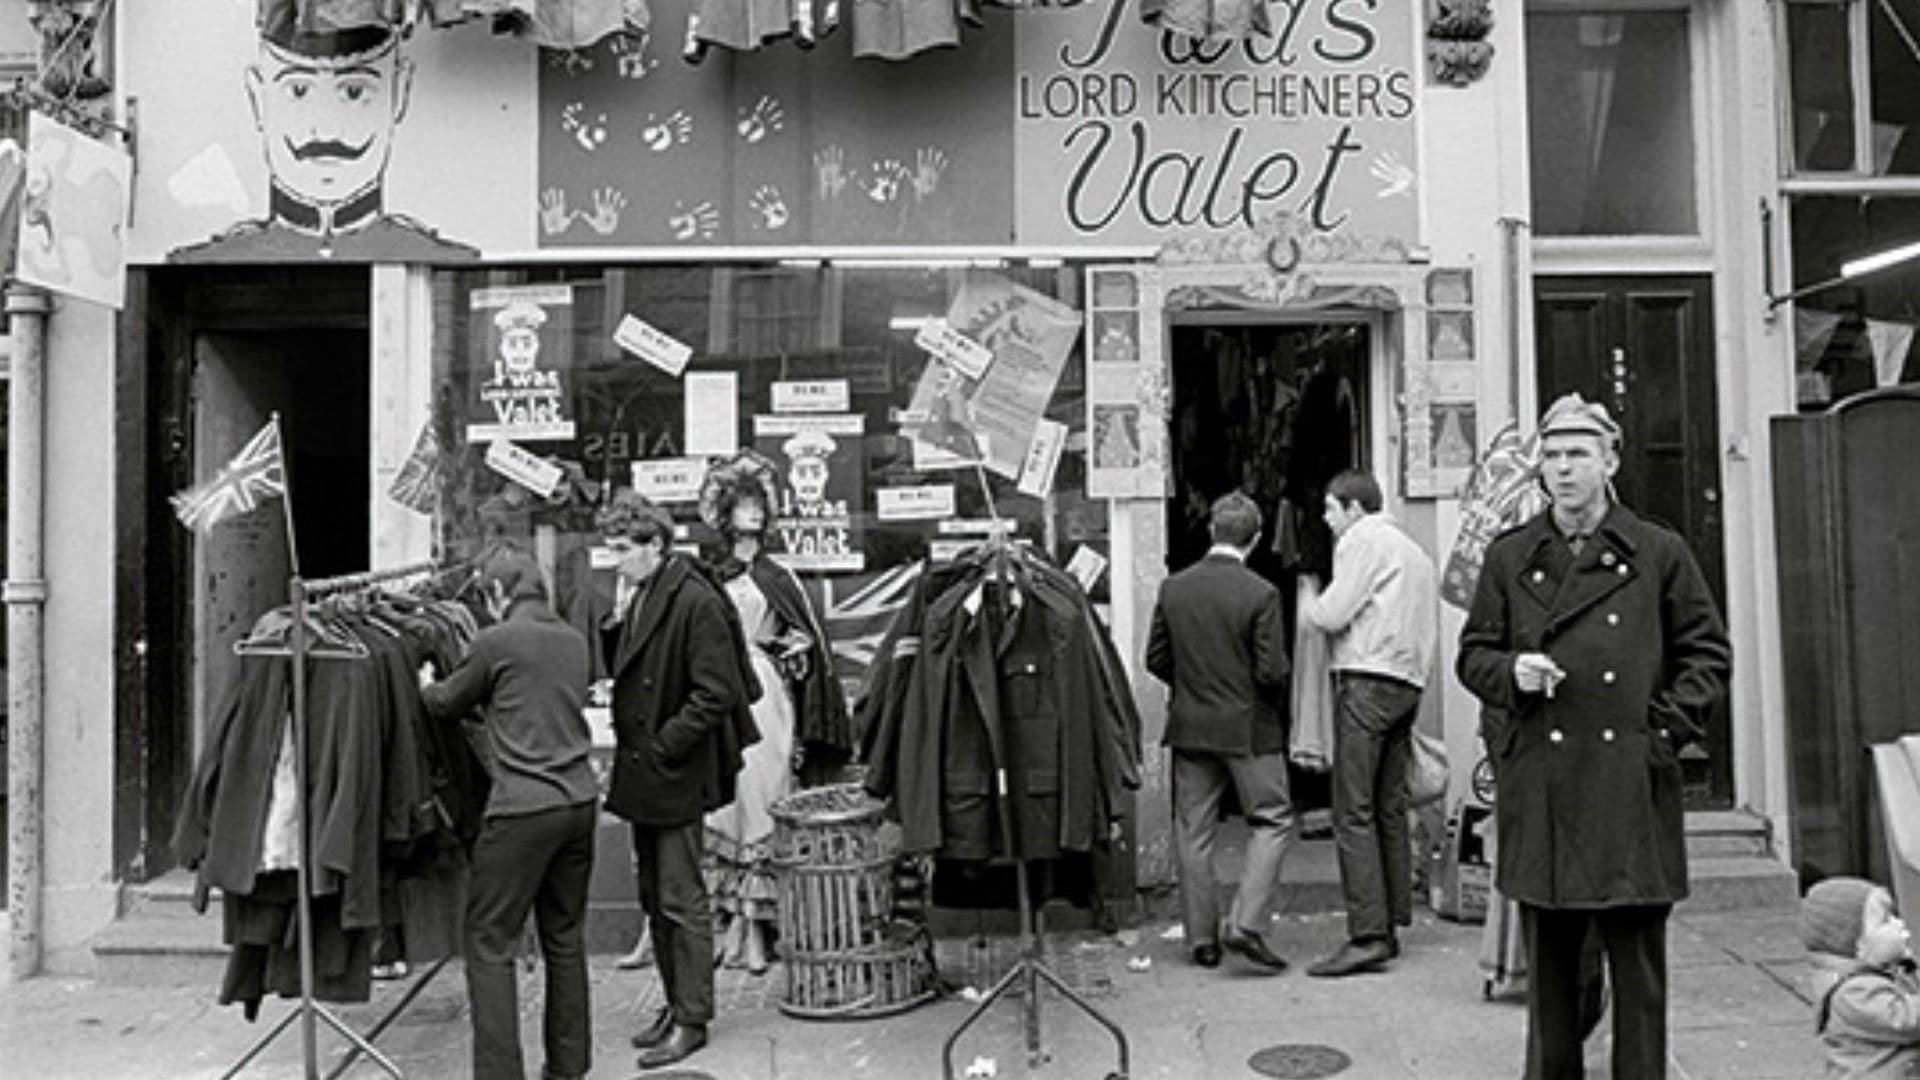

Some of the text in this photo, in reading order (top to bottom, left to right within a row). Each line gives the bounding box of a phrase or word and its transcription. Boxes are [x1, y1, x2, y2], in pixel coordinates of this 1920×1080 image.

[1021, 73, 1137, 118] LORD
[1063, 120, 1363, 231] Valet
[492, 398, 562, 424] Valet
[781, 529, 850, 555] Valet
